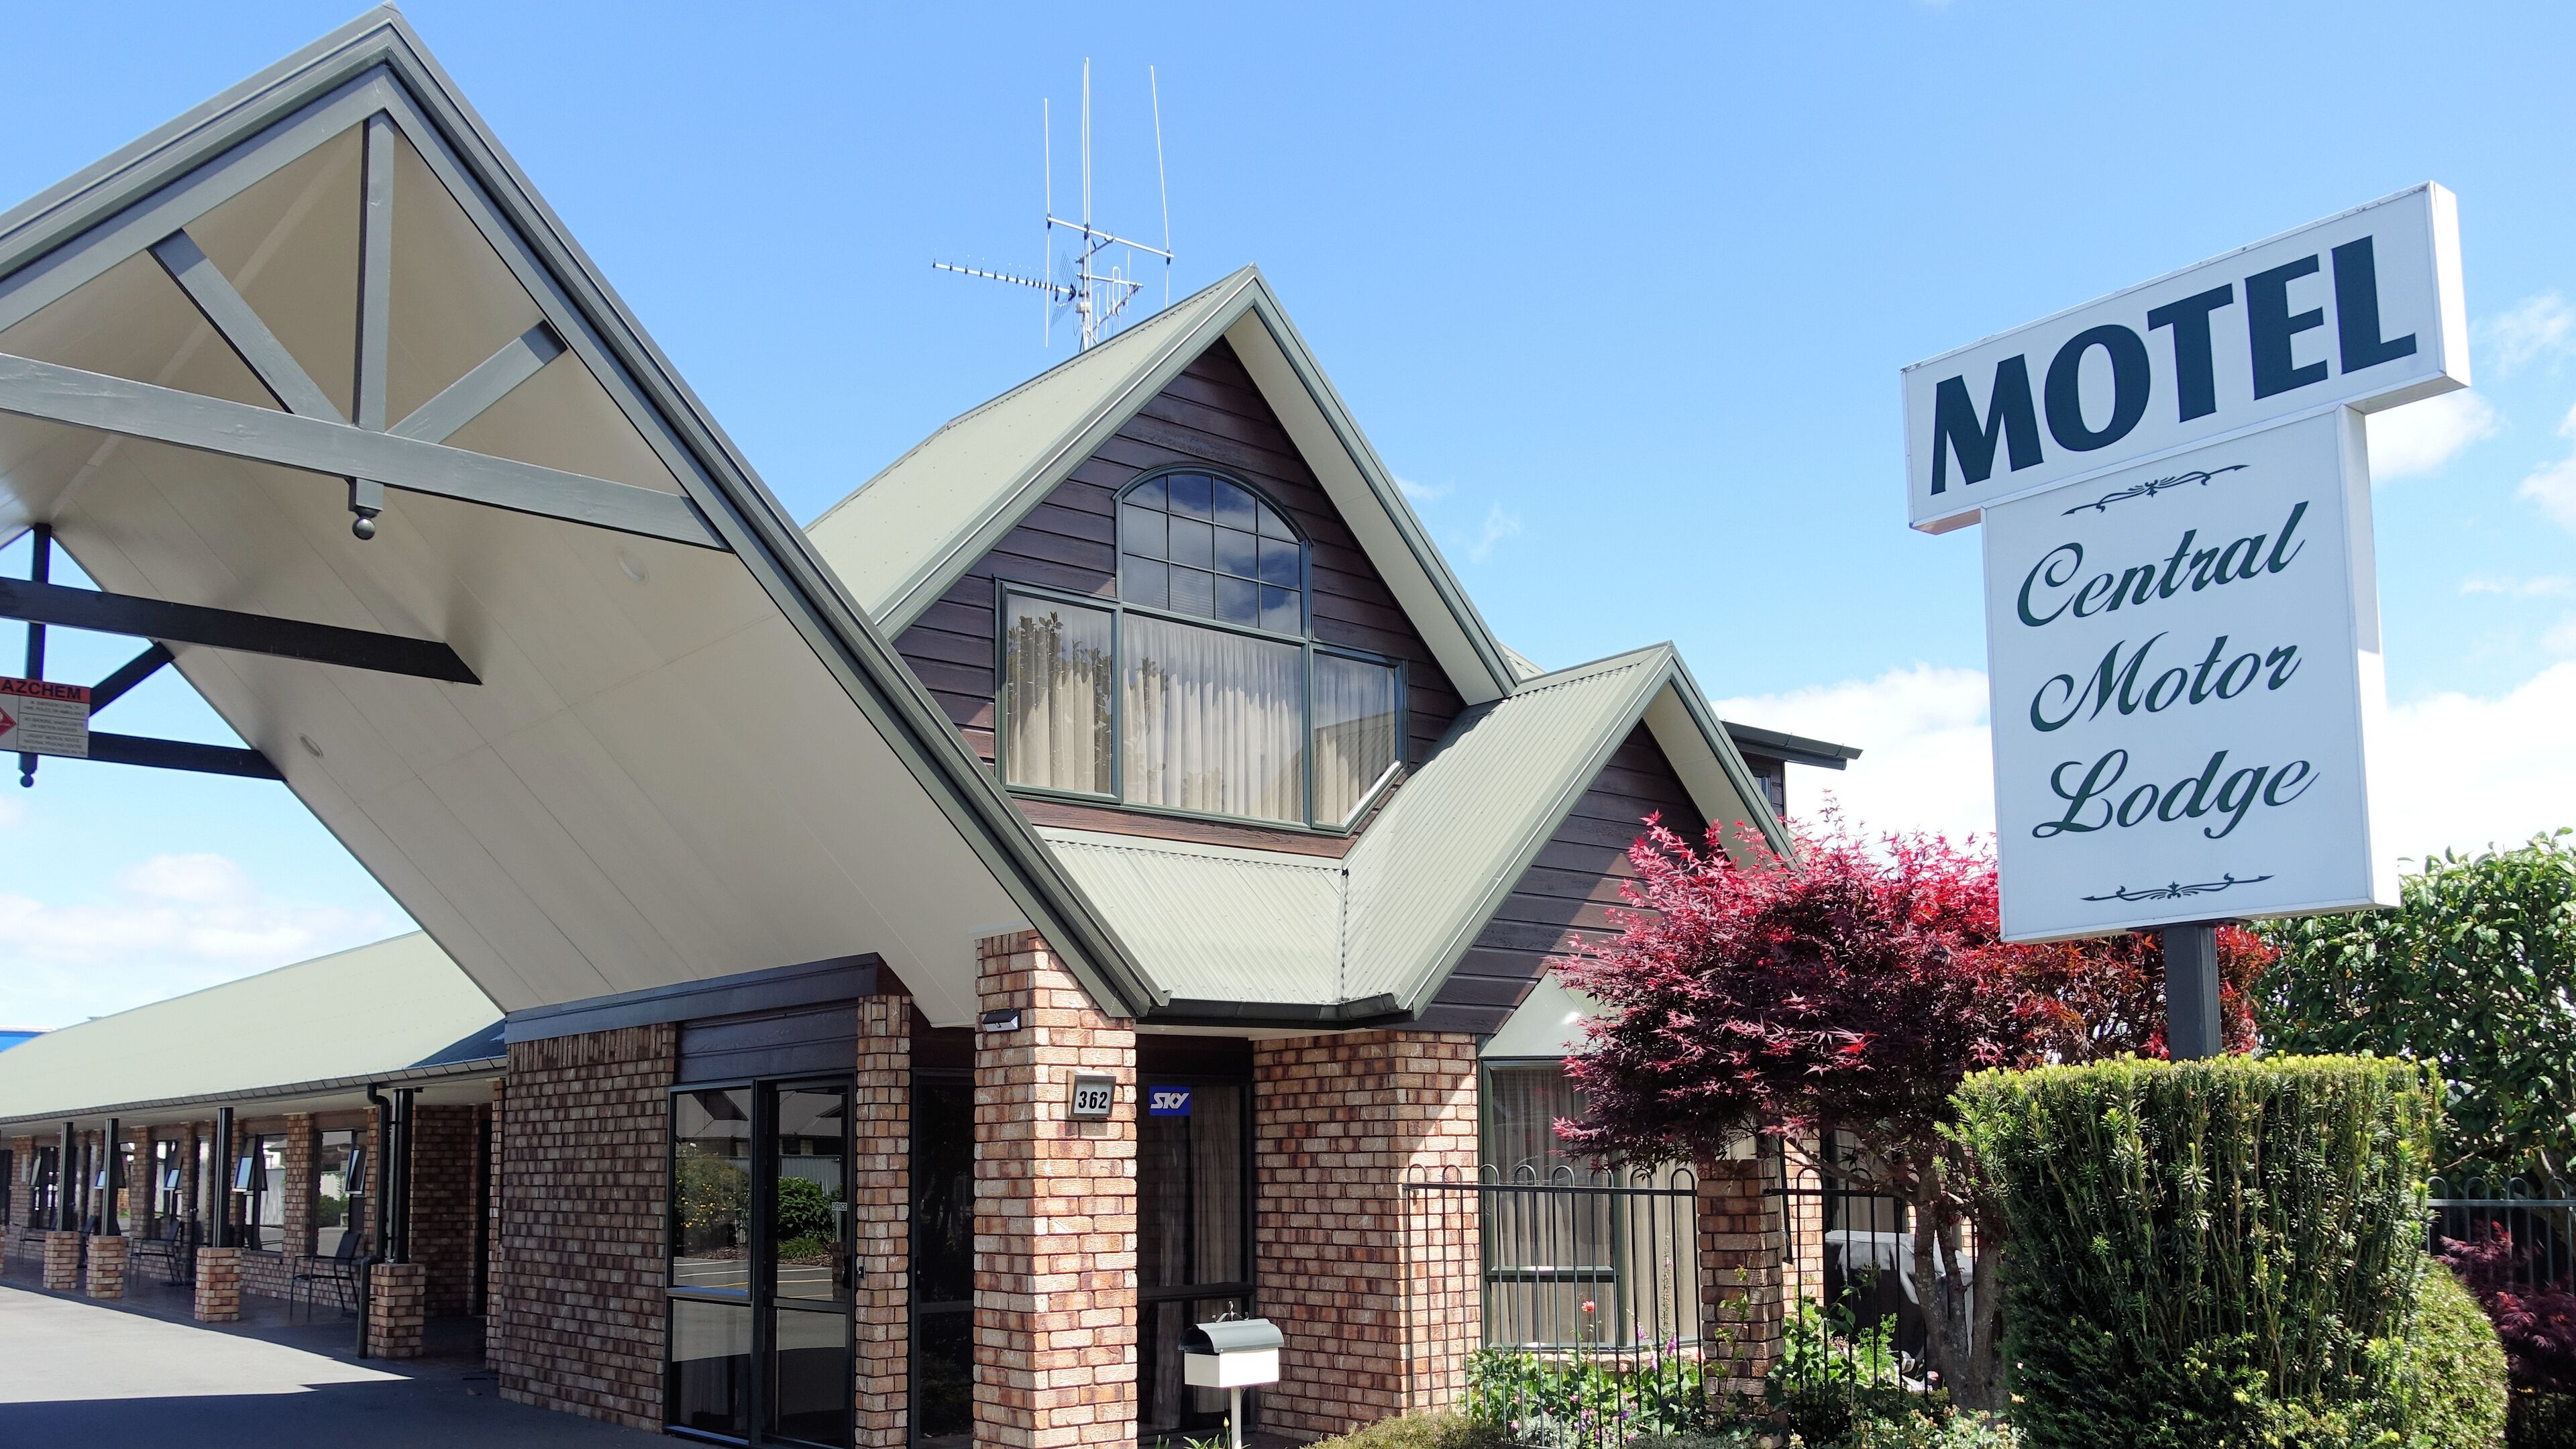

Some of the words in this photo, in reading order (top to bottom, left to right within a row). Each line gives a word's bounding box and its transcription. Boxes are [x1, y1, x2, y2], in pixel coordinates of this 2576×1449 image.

[1930, 234, 2418, 496] MOTEL
[2017, 500, 2310, 627] Central
[2030, 631, 2302, 733] Motor
[2031, 749, 2320, 839] Lodge
[1078, 1090, 1108, 1110] 362
[1150, 1092, 1189, 1109] SKY
[833, 1202, 847, 1210] OFFICE
